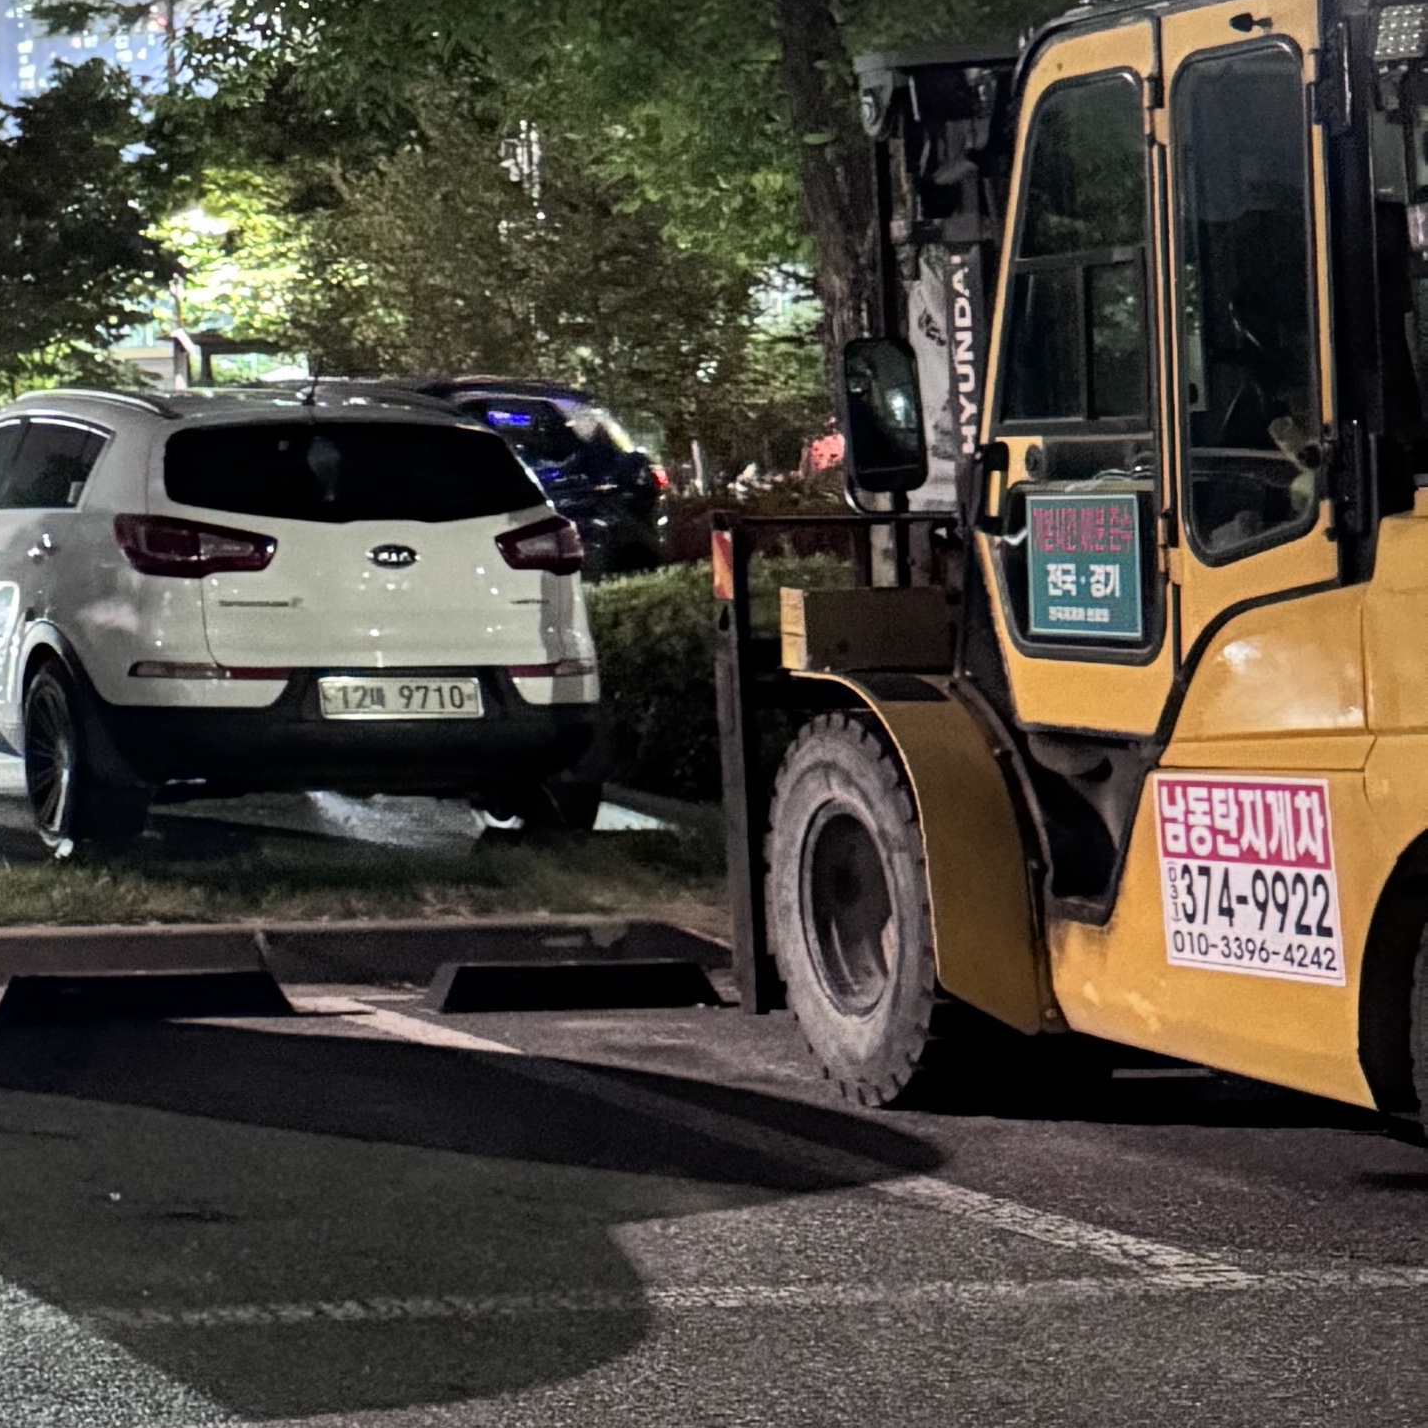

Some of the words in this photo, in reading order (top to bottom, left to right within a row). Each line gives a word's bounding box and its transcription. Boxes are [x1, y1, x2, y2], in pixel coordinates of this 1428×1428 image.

[398, 684, 465, 710] 9710
[1160, 786, 1325, 864] 남동탄지게차
[1181, 863, 1333, 938] 374-9922
[1173, 930, 1337, 971] 010-3396-4242
